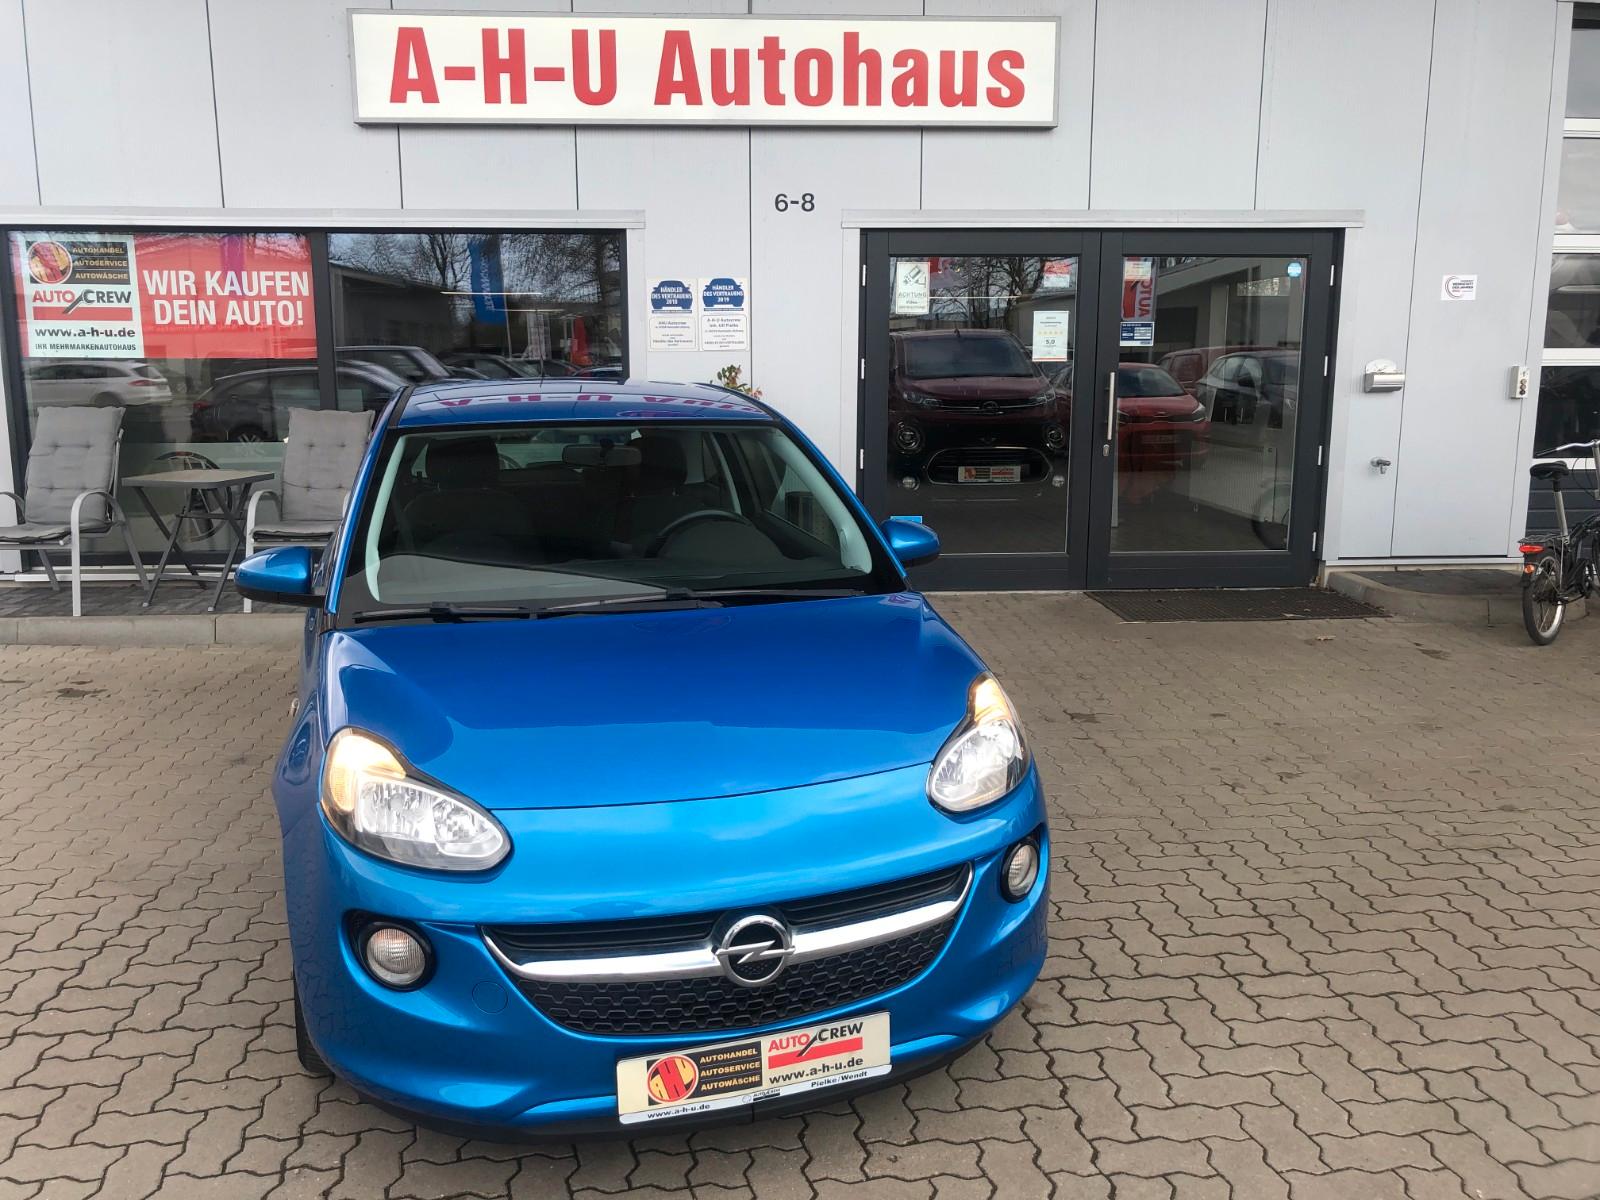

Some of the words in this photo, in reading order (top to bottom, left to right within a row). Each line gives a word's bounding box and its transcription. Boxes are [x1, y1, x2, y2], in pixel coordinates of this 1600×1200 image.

[389, 26, 618, 106] A-H-U
[653, 29, 1026, 108] Autohaus
[774, 192, 816, 213] 6-8
[75, 272, 129, 280] AUTOWÄSCHE
[142, 270, 196, 297] WIR
[205, 270, 310, 297] KAUFEN
[153, 300, 217, 326] DEIN
[225, 299, 304, 326] AUTO!
[35, 327, 136, 338] www.a-h-u.de
[49, 343, 136, 351] MEHRMARKENAUTOHAUS
[767, 1032, 810, 1053] AUTO
[817, 1021, 864, 1042] CREW
[700, 1048, 759, 1063] AUTOHANDEL
[700, 1061, 761, 1077] AUTOSERVICE
[769, 1056, 864, 1084] www.a-h-u.de
[700, 1074, 761, 1091] AUTOWÄSCHE
[647, 1103, 711, 1119] www.a-h-u.de
